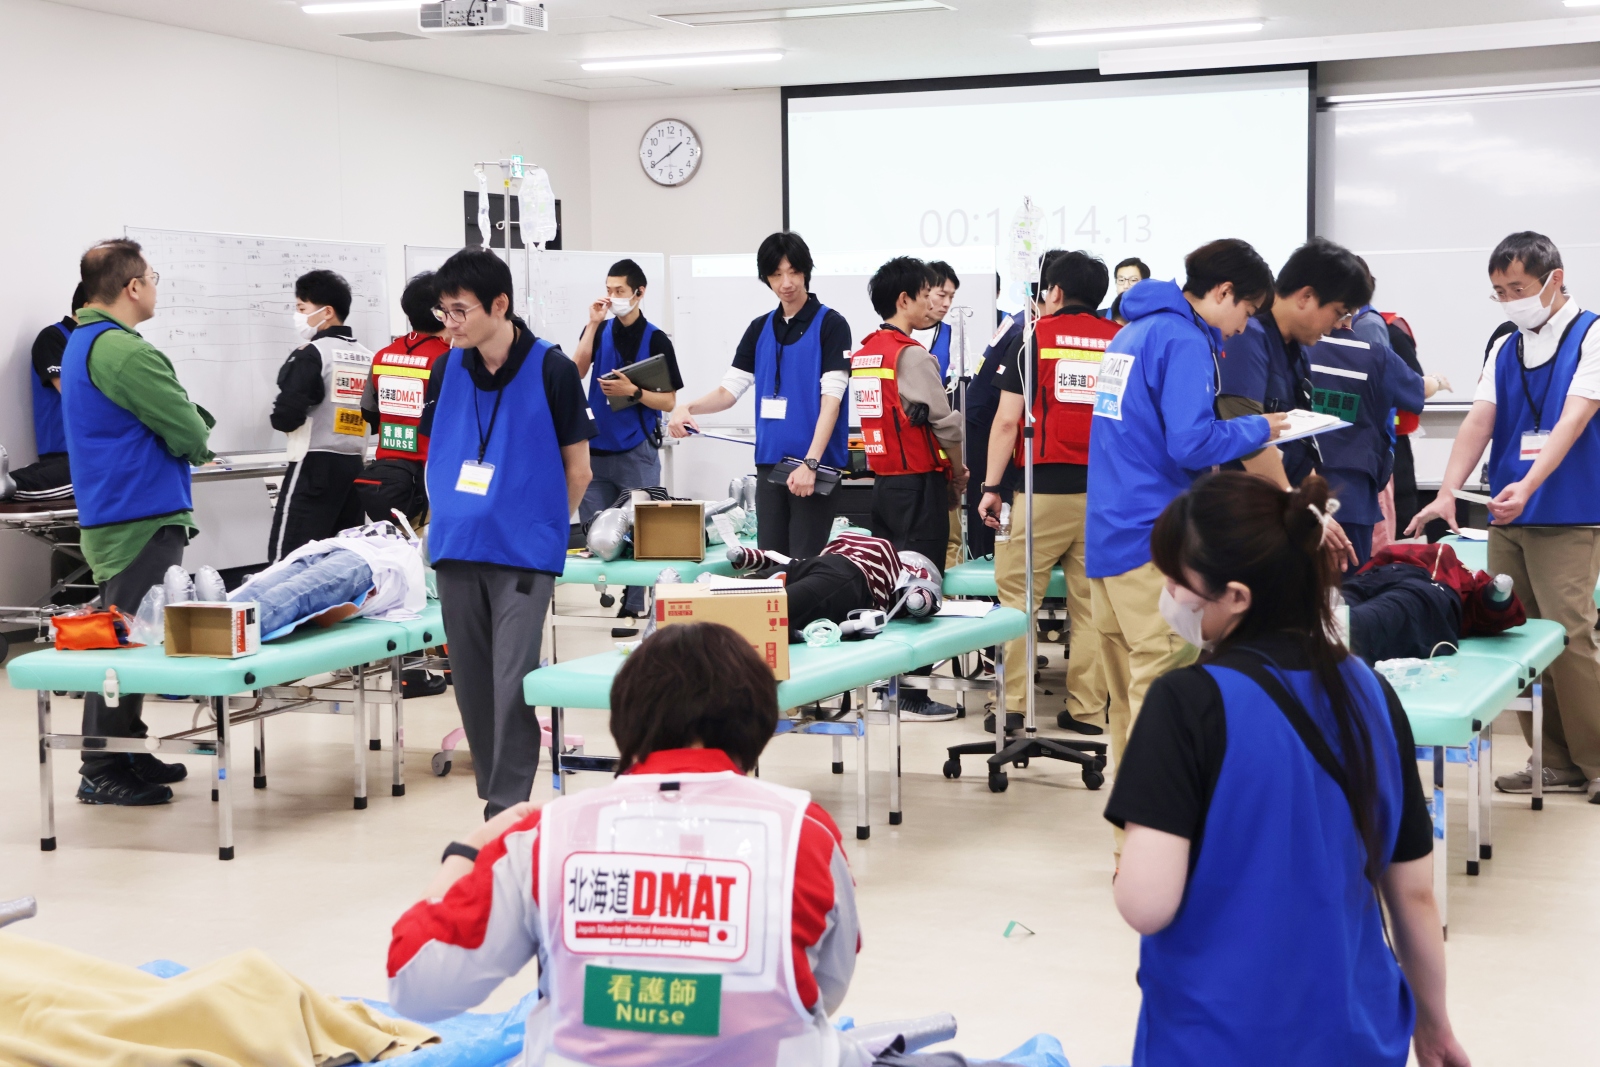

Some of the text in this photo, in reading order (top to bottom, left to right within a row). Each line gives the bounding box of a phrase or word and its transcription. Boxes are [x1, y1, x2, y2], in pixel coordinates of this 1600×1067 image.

[658, 129, 664, 137] 11
[667, 126, 675, 134] 12
[679, 129, 683, 137] 1
[650, 138, 658, 146] 10
[686, 136, 691, 145] 2
[647, 149, 652, 157] 9
[689, 148, 694, 156] 3
[650, 160, 655, 168] 8
[686, 160, 691, 168] 4
[668, 171, 673, 179] 6
[1058, 372, 1099, 388] 北海道D
[383, 425, 414, 440] 看護師
[383, 438, 414, 450] NURSE
[568, 866, 737, 922] 北海道DMAT
[577, 924, 708, 938] Japan Disaster Medical Assistance Team
[607, 974, 698, 1007] 看護師
[616, 1003, 686, 1025] Nurse
